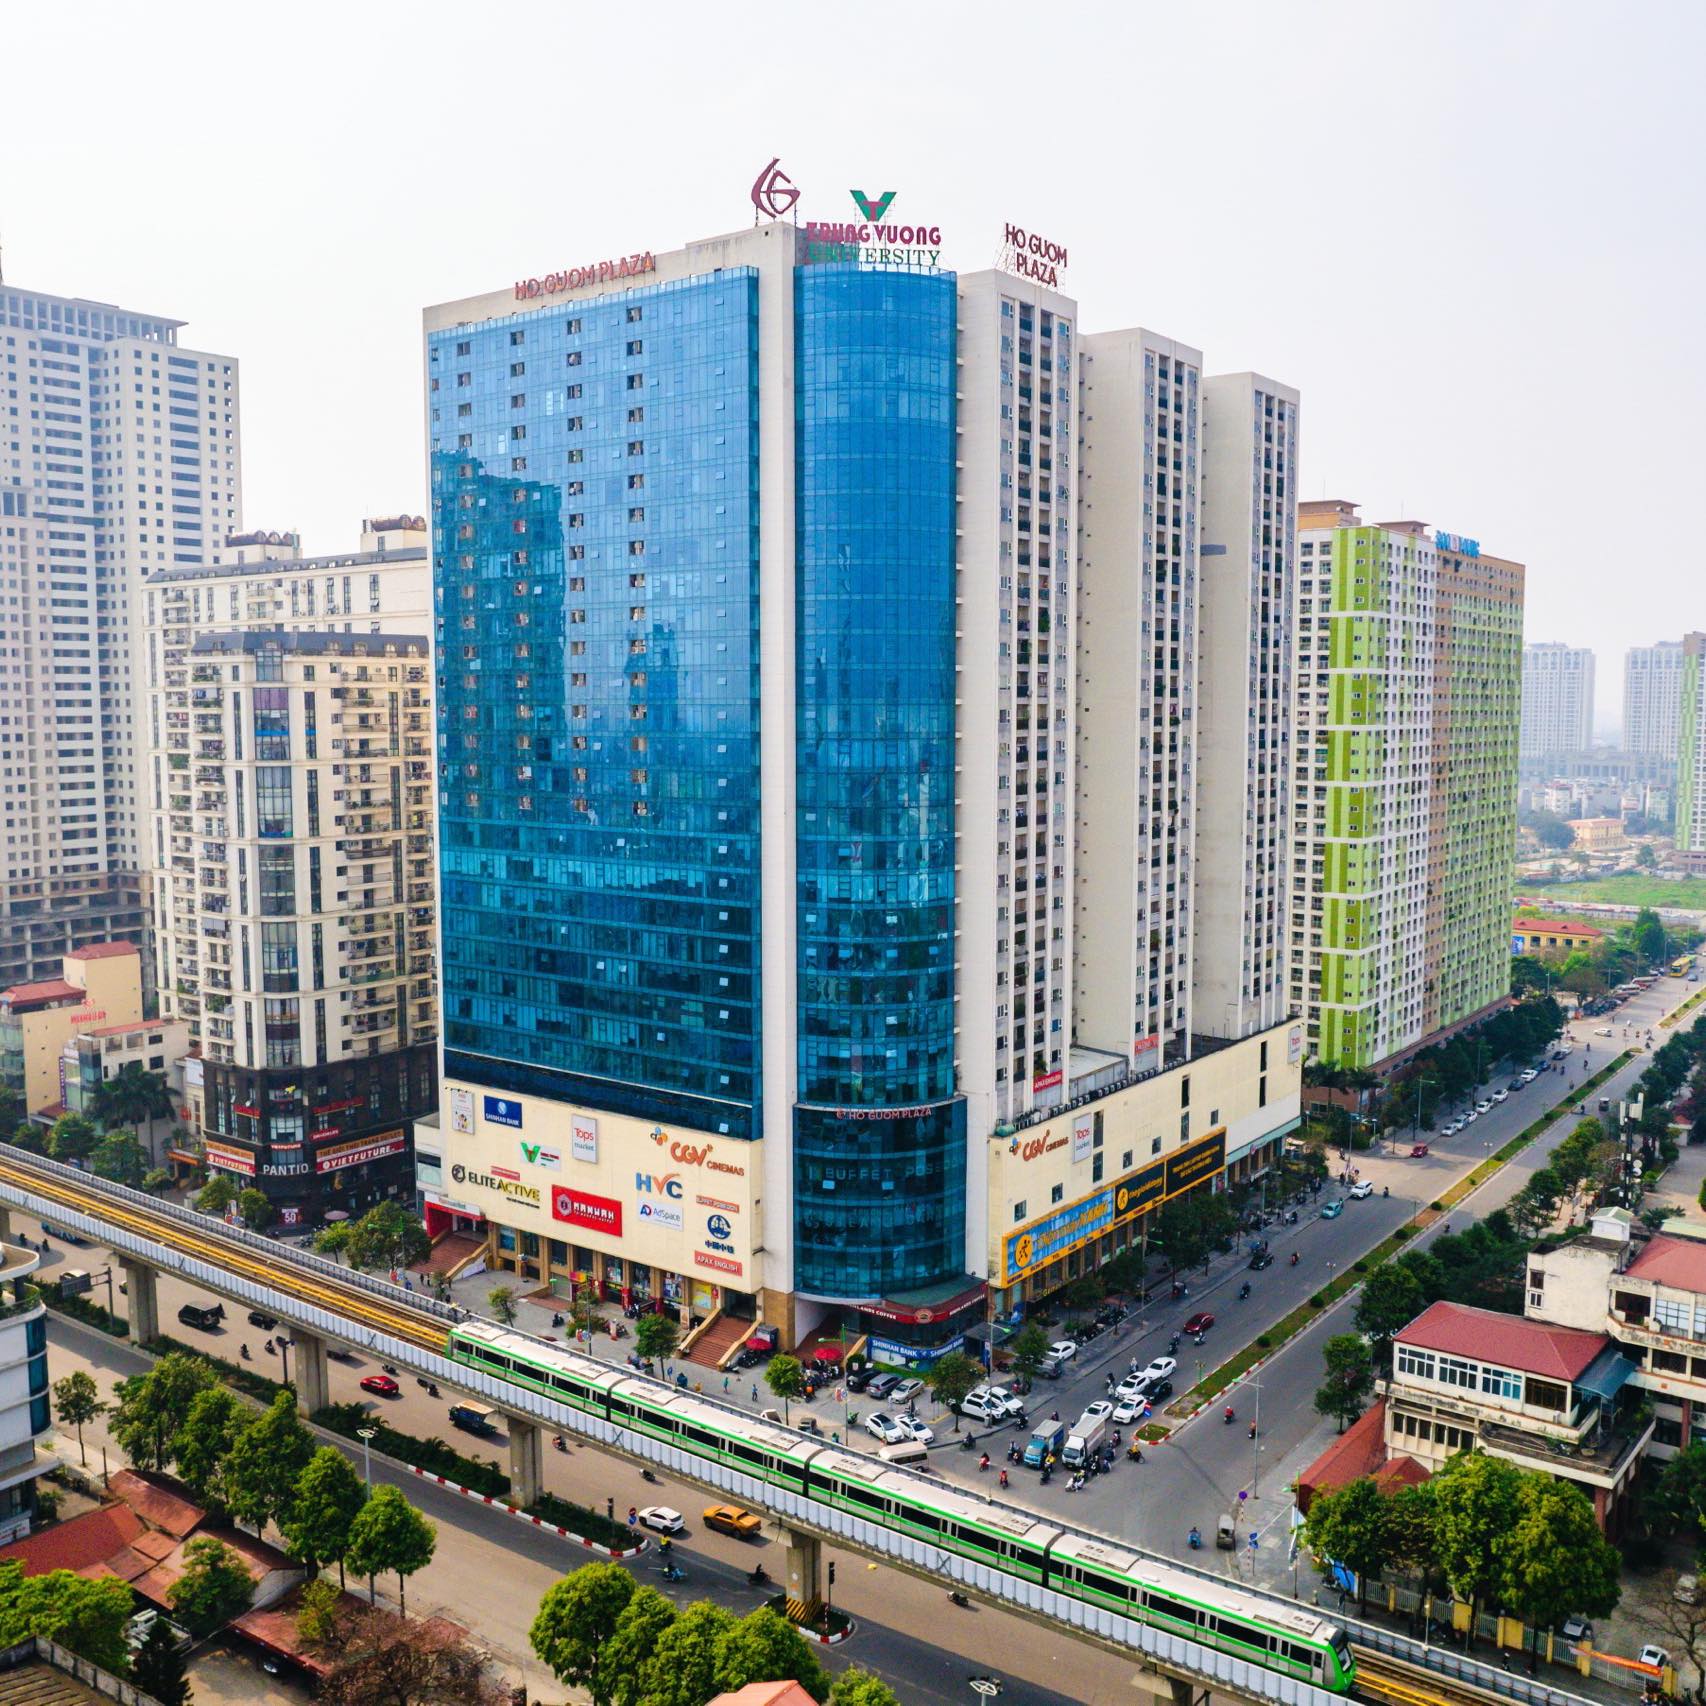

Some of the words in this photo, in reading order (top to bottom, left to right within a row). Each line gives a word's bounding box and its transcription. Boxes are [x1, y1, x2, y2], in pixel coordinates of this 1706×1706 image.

[806, 222, 871, 243] TRUNG
[873, 225, 942, 246] VUONG
[1005, 222, 1026, 249] HO
[1029, 234, 1067, 268] GUOM
[515, 278, 540, 300] HO
[544, 264, 595, 293] GUOM
[599, 251, 656, 283] PLAZA
[1016, 252, 1057, 287] PLAZA
[849, 1109, 865, 1120] HO
[868, 1109, 900, 1120] GUOM
[902, 1106, 932, 1119] PLAZA
[506, 1117, 520, 1127] BANK
[574, 1128, 594, 1142] Tops
[574, 1142, 594, 1152] market
[1023, 1135, 1047, 1161] CGV
[331, 1145, 391, 1167] VIETFUTURE
[670, 1141, 707, 1167] CGV
[706, 1160, 745, 1177] CINEMAS
[263, 1163, 308, 1176] PANTIO
[825, 1168, 892, 1180] BUFFET
[635, 1172, 683, 1199] HVC
[653, 1207, 681, 1222] AdSpace
[876, 1310, 897, 1320] COFFEE
[872, 1340, 900, 1352] SHINHAN
[900, 1346, 918, 1357] BANK
